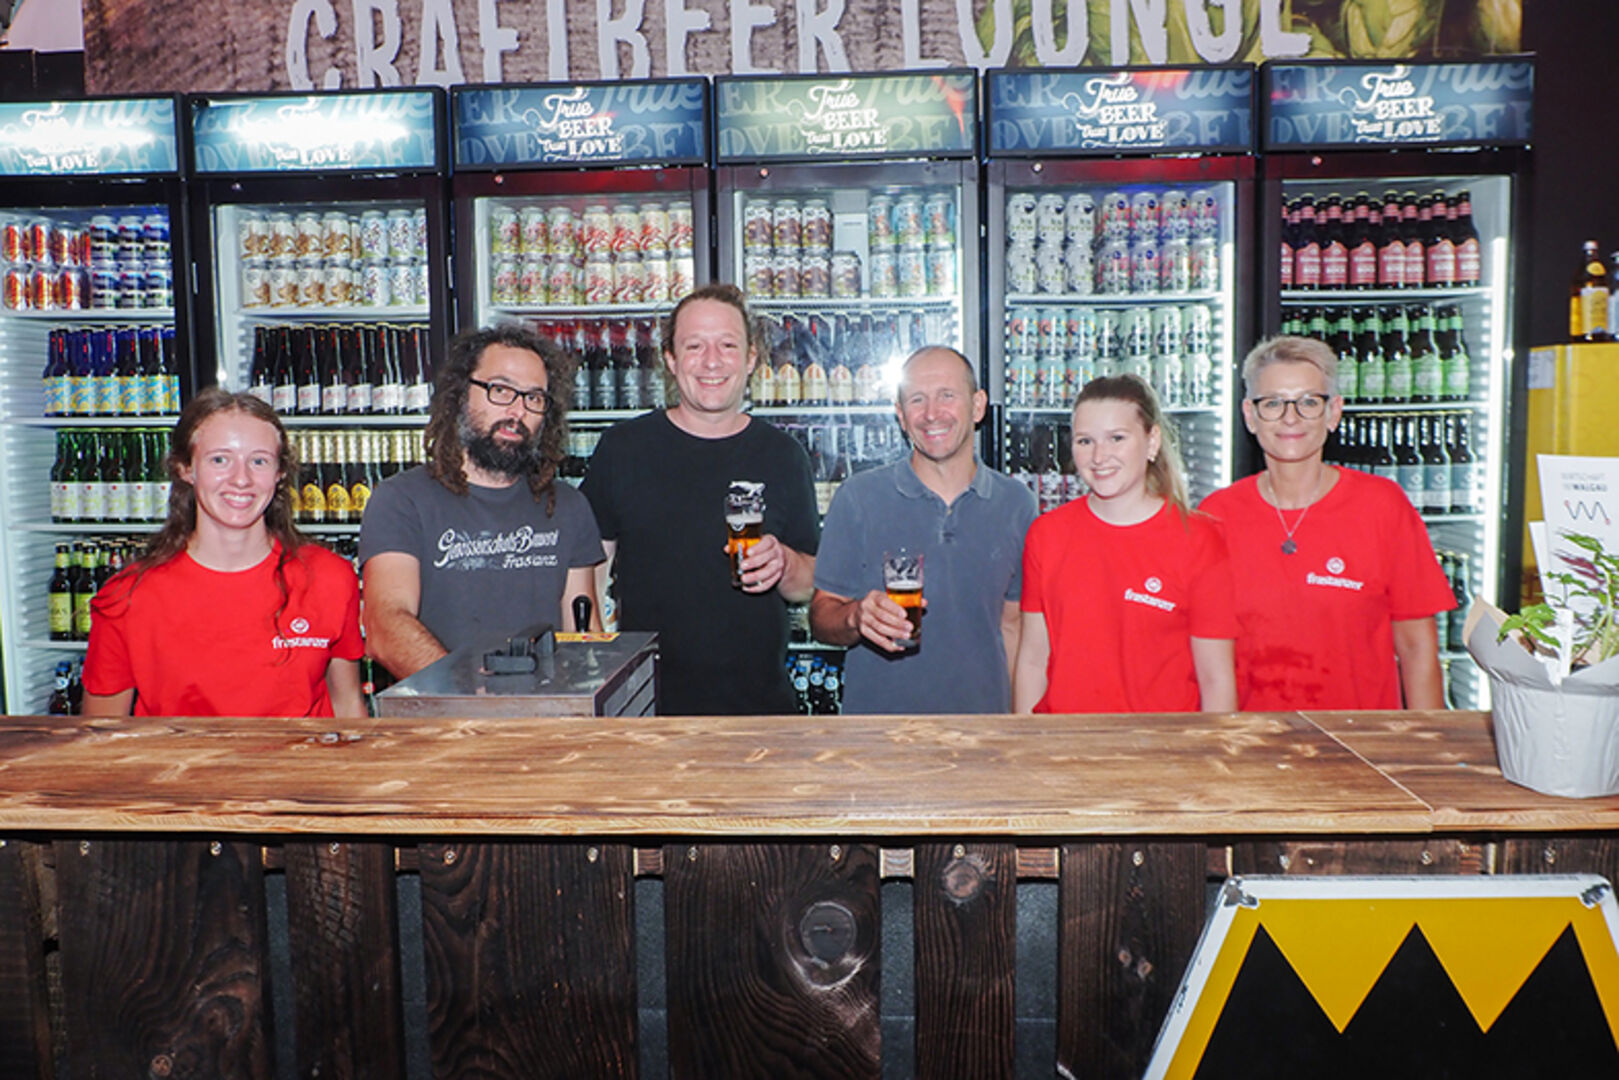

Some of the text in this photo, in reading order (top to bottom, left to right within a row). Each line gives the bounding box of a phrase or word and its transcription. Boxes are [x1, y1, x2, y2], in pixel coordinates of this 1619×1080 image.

[1076, 72, 1138, 115] True
[1356, 64, 1416, 109] True
[538, 87, 595, 128] True
[803, 79, 860, 119] True
[1375, 96, 1435, 119] BEER
[822, 108, 880, 130] BEER
[1099, 102, 1158, 124] BEER
[558, 116, 615, 138] BEER
[831, 126, 889, 149] LOVE
[1107, 121, 1167, 143] LOVE
[1383, 115, 1444, 138] LOVE
[567, 136, 625, 156] LOVE
